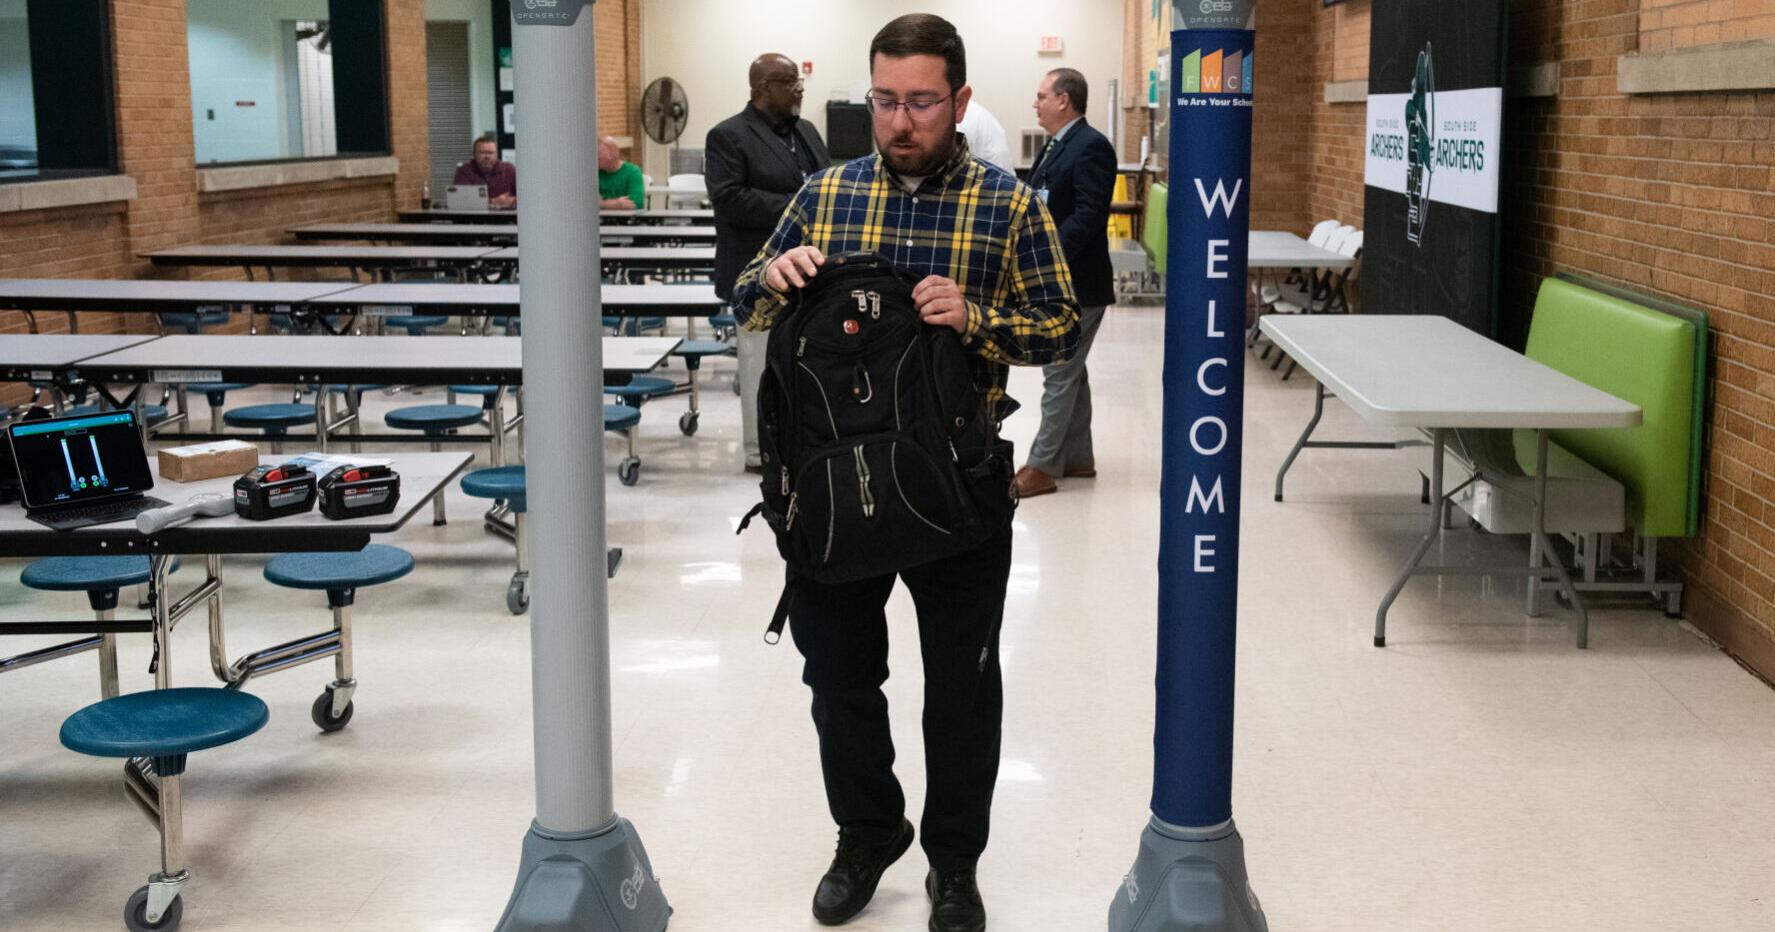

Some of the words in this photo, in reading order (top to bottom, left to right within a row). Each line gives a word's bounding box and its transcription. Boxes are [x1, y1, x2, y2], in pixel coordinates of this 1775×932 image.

[1177, 98, 1188, 106] We
[1190, 98, 1207, 106] Are
[1209, 98, 1231, 106] Your
[1444, 120, 1461, 131] SOUTH
[1463, 120, 1477, 132] SIDE
[1370, 132, 1404, 161] ARCHERS
[1436, 138, 1484, 175] ARCHERS
[1185, 177, 1243, 572] WELCOME
